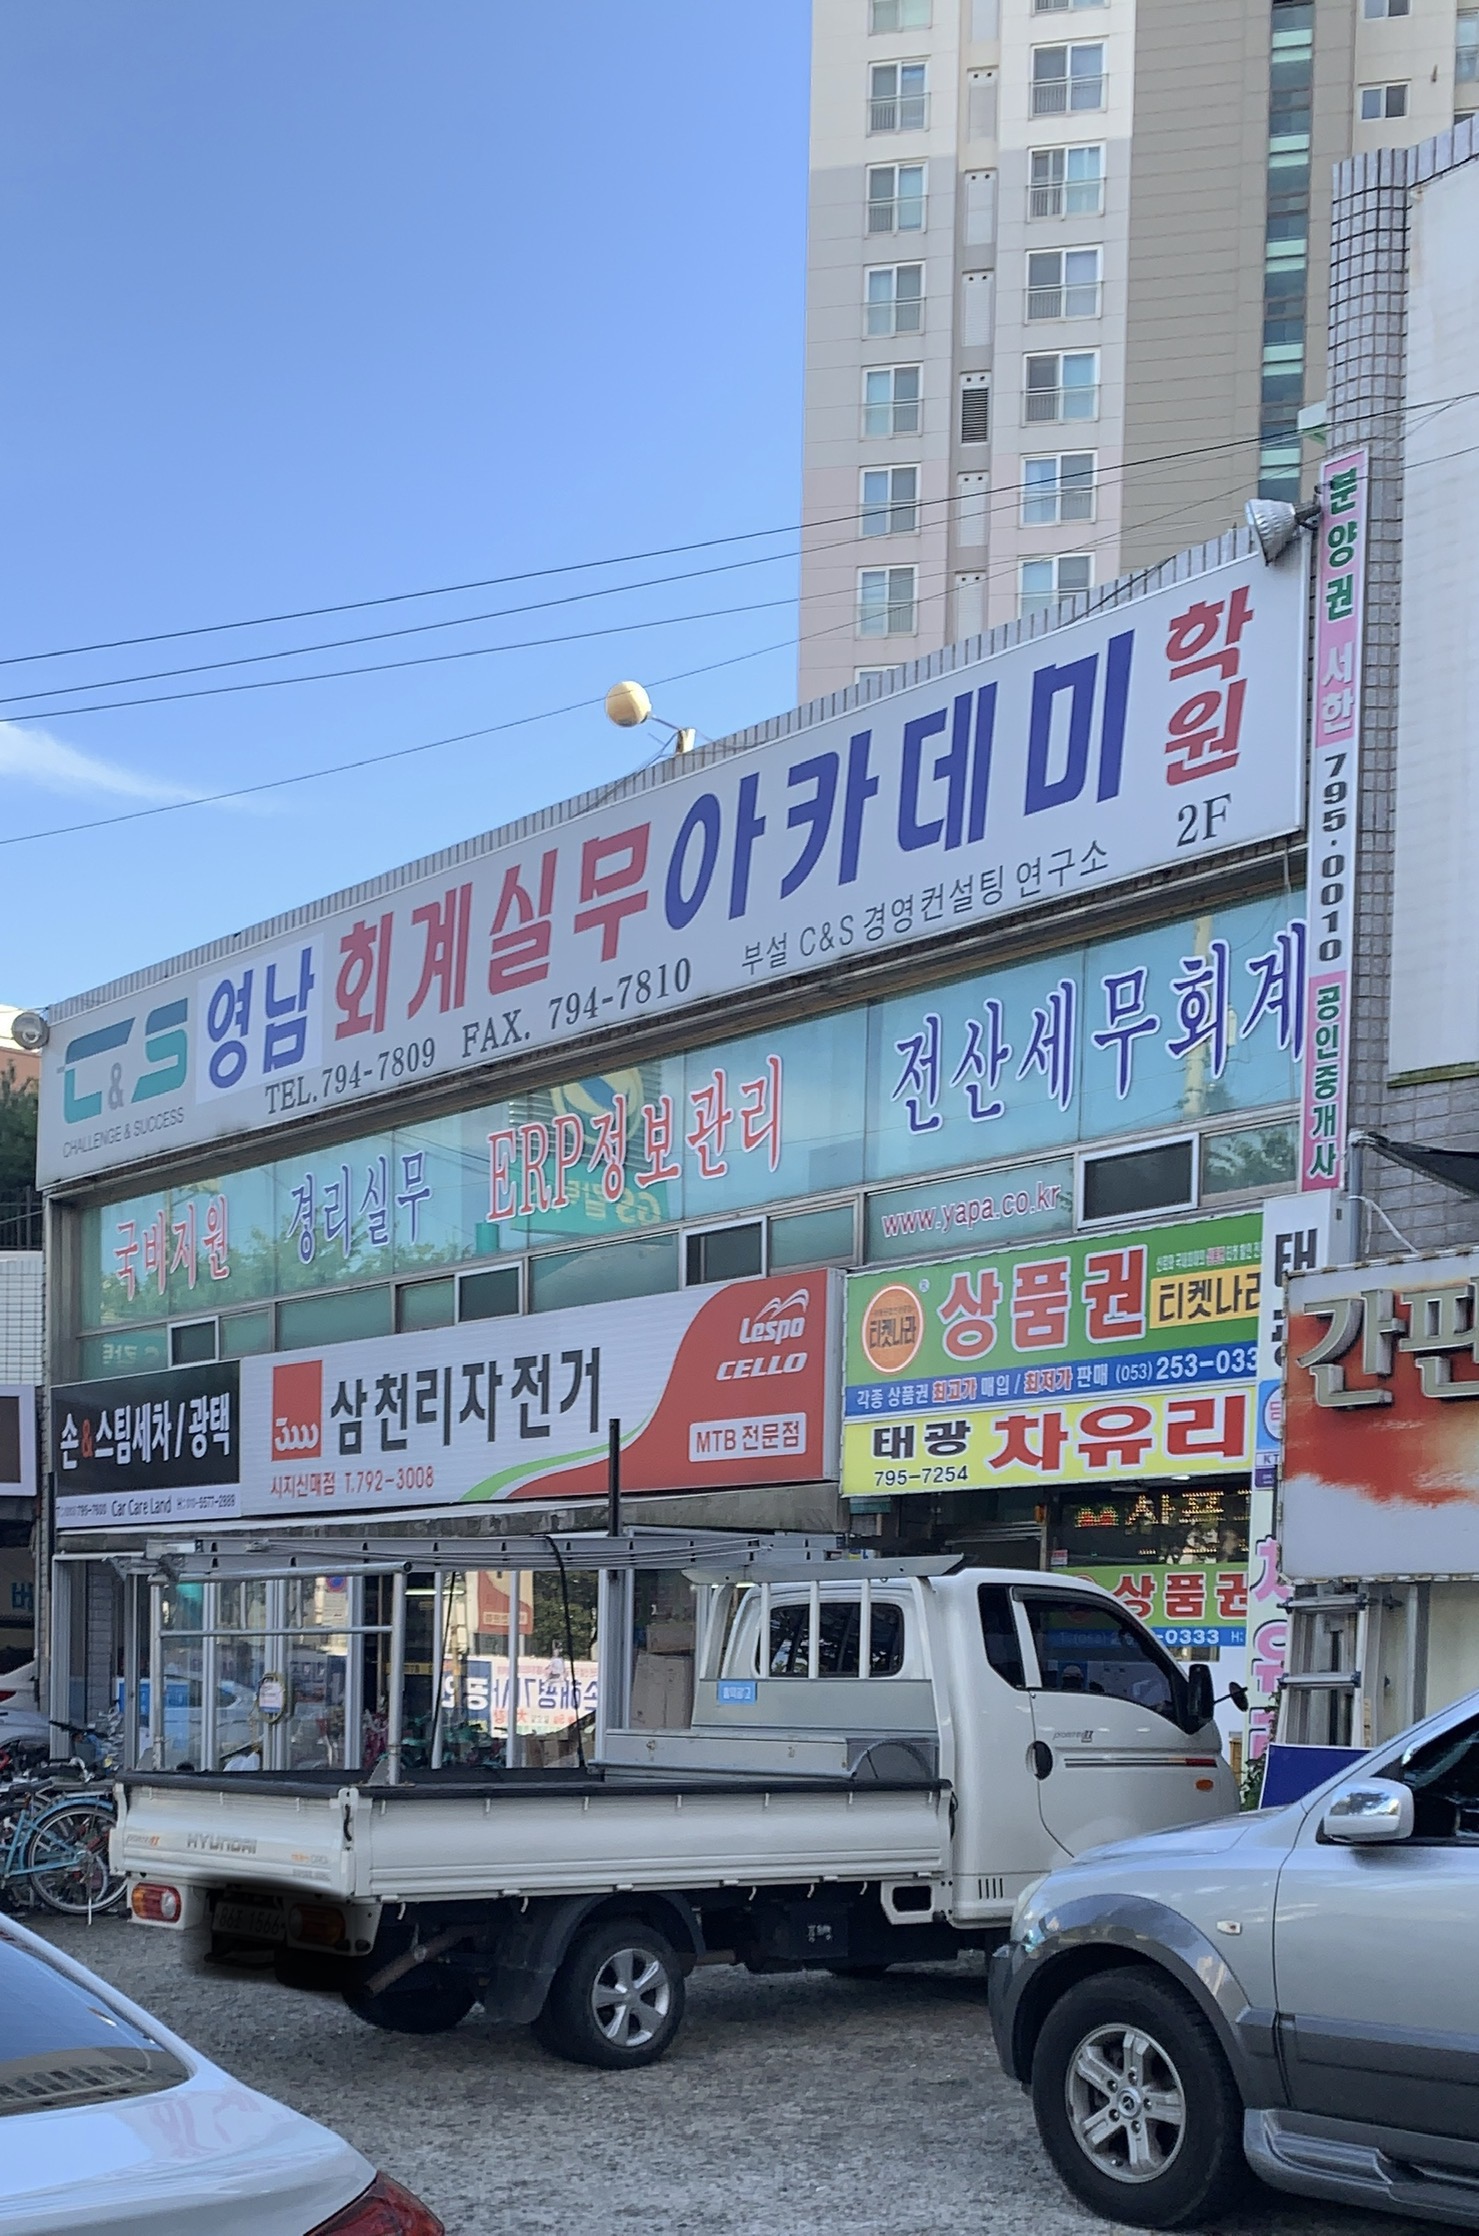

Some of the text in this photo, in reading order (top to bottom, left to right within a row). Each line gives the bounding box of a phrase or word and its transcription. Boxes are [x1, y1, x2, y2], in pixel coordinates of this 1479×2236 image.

[1325, 466, 1358, 621] 분양권
[1165, 585, 1254, 786] 학원
[1321, 640, 1355, 737] 서한
[1177, 793, 1232, 848] 2F
[741, 932, 788, 975] 부설
[799, 915, 854, 956] C&S
[1015, 840, 1110, 899] 연구소
[207, 945, 316, 1090] 영남
[461, 1010, 530, 1058] FAX.
[549, 958, 692, 1031] 794-7810
[1308, 983, 1341, 1179] 공인중개사
[62, 1126, 122, 1158] CHALLENGE
[132, 1106, 185, 1137] SUCCESS
[113, 1194, 231, 1301] 국비지원
[287, 1148, 434, 1264] 경리실무
[881, 1181, 1063, 1238] www.yapa.co.kr
[738, 1317, 806, 1345] Lespo
[936, 1243, 1149, 1362] 상품권
[330, 1345, 600, 1456] 삼천리자전거
[715, 1352, 808, 1381] CELLO
[856, 1389, 884, 1410] 각종
[887, 1383, 929, 1407] 상품권
[932, 1377, 978, 1404] 최고가
[981, 1374, 1010, 1398] 매입
[1023, 1365, 1073, 1394] 최저가
[1076, 1362, 1109, 1388] 판매
[1115, 1360, 1153, 1383] (053)
[696, 1420, 800, 1454] MTB 전문점
[871, 1418, 972, 1462] 태광
[988, 1393, 1248, 1474] 차유리
[873, 1464, 969, 1487] 795-7254
[111, 1499, 127, 1517] Car
[127, 1498, 149, 1516] Care
[150, 1495, 172, 1515] Land
[186, 1832, 258, 1856] HYUNDAI
